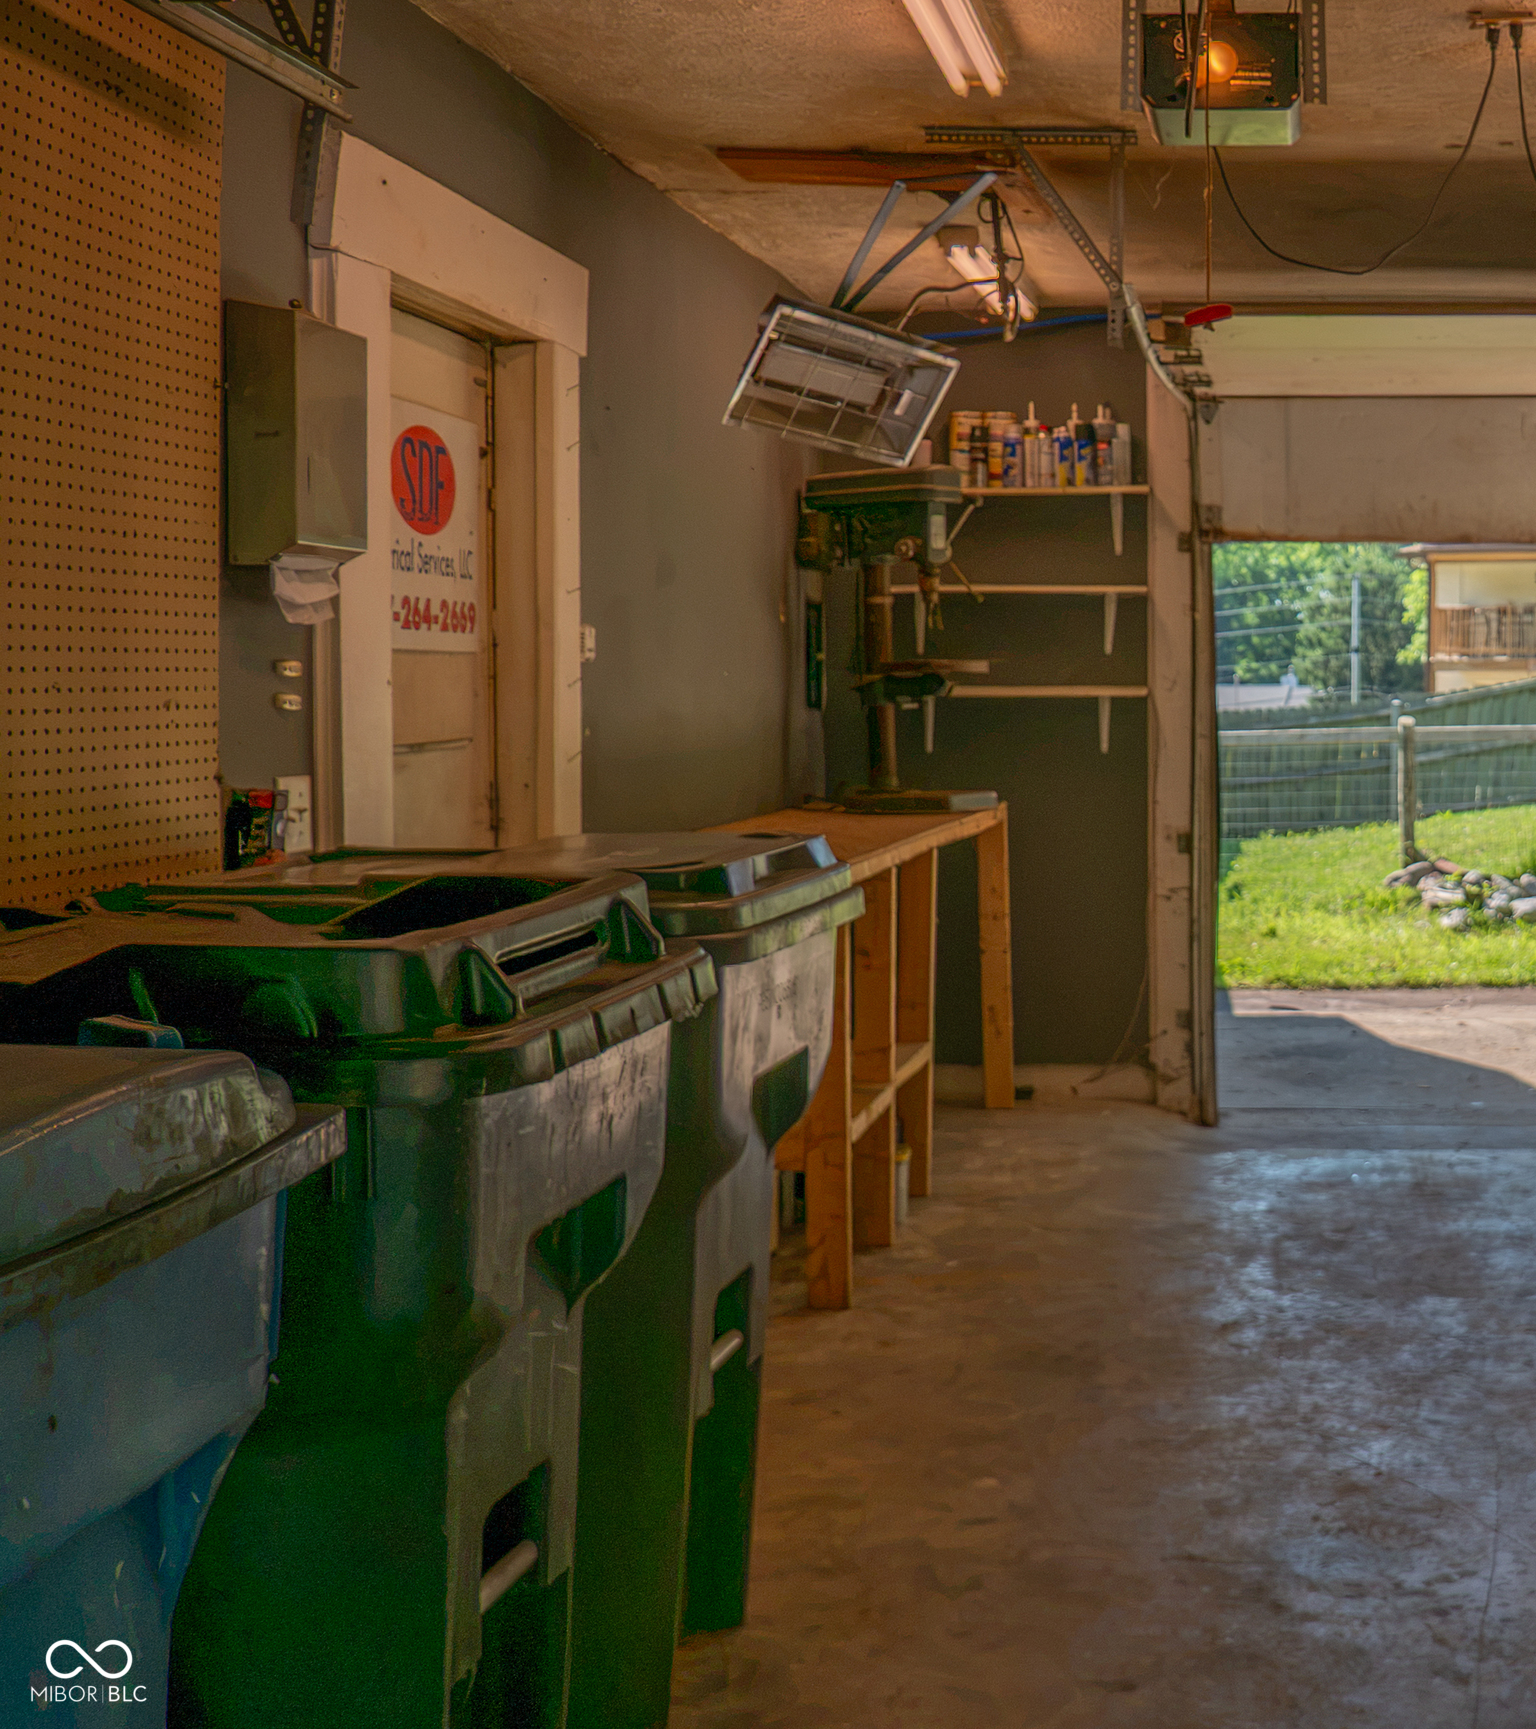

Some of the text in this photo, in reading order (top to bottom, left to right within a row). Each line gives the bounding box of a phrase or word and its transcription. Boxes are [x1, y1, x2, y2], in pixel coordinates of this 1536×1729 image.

[399, 436, 447, 525] SDF
[417, 541, 456, 581] Services,
[459, 547, 473, 580] LLC
[391, 594, 476, 634] -264-2669
